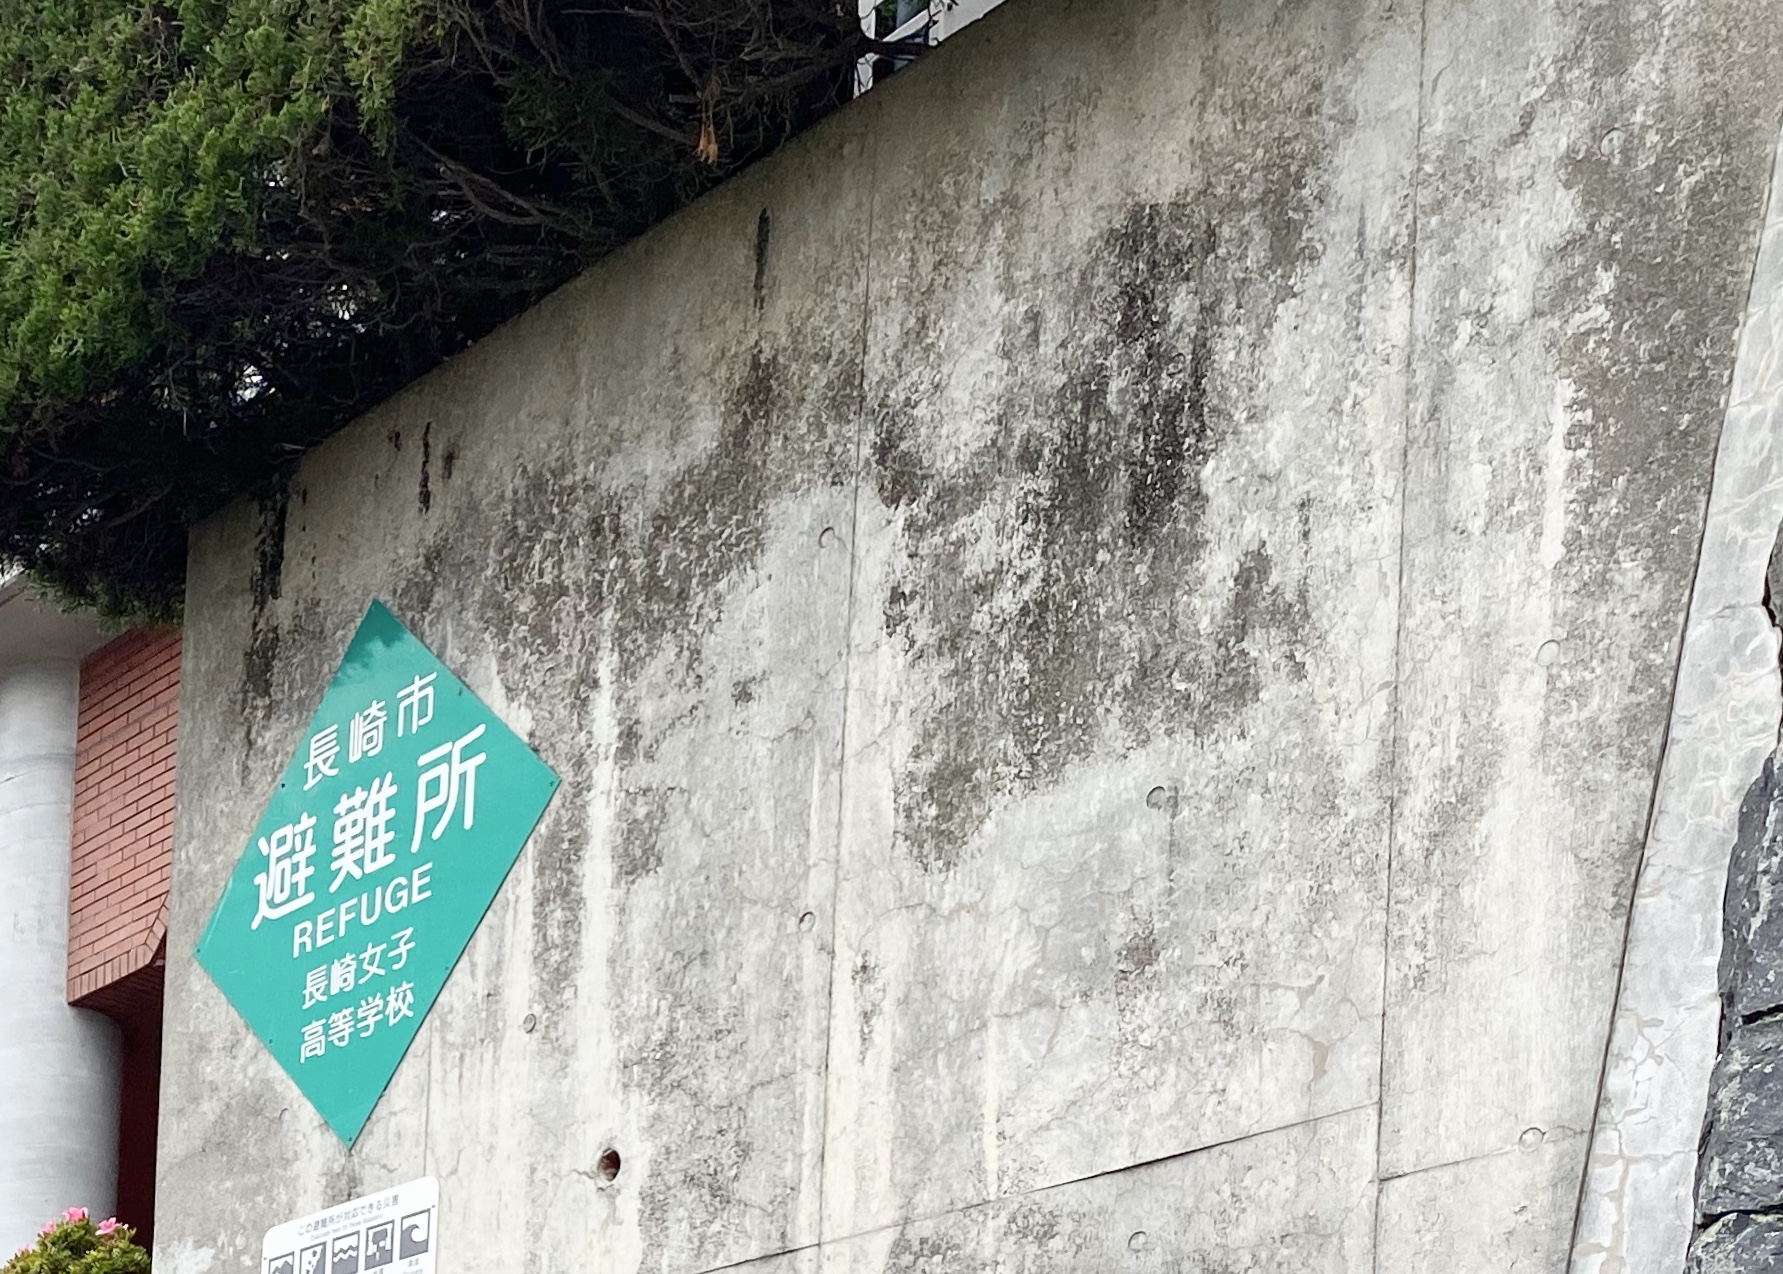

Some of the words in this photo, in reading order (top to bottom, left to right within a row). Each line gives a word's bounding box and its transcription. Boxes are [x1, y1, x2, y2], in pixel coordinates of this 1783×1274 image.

[303, 671, 438, 791] 長崎市
[251, 723, 487, 930] 避難所
[292, 861, 433, 958] REFUGE
[301, 927, 416, 1011] 長崎女子
[299, 980, 415, 1064] 高等学校
